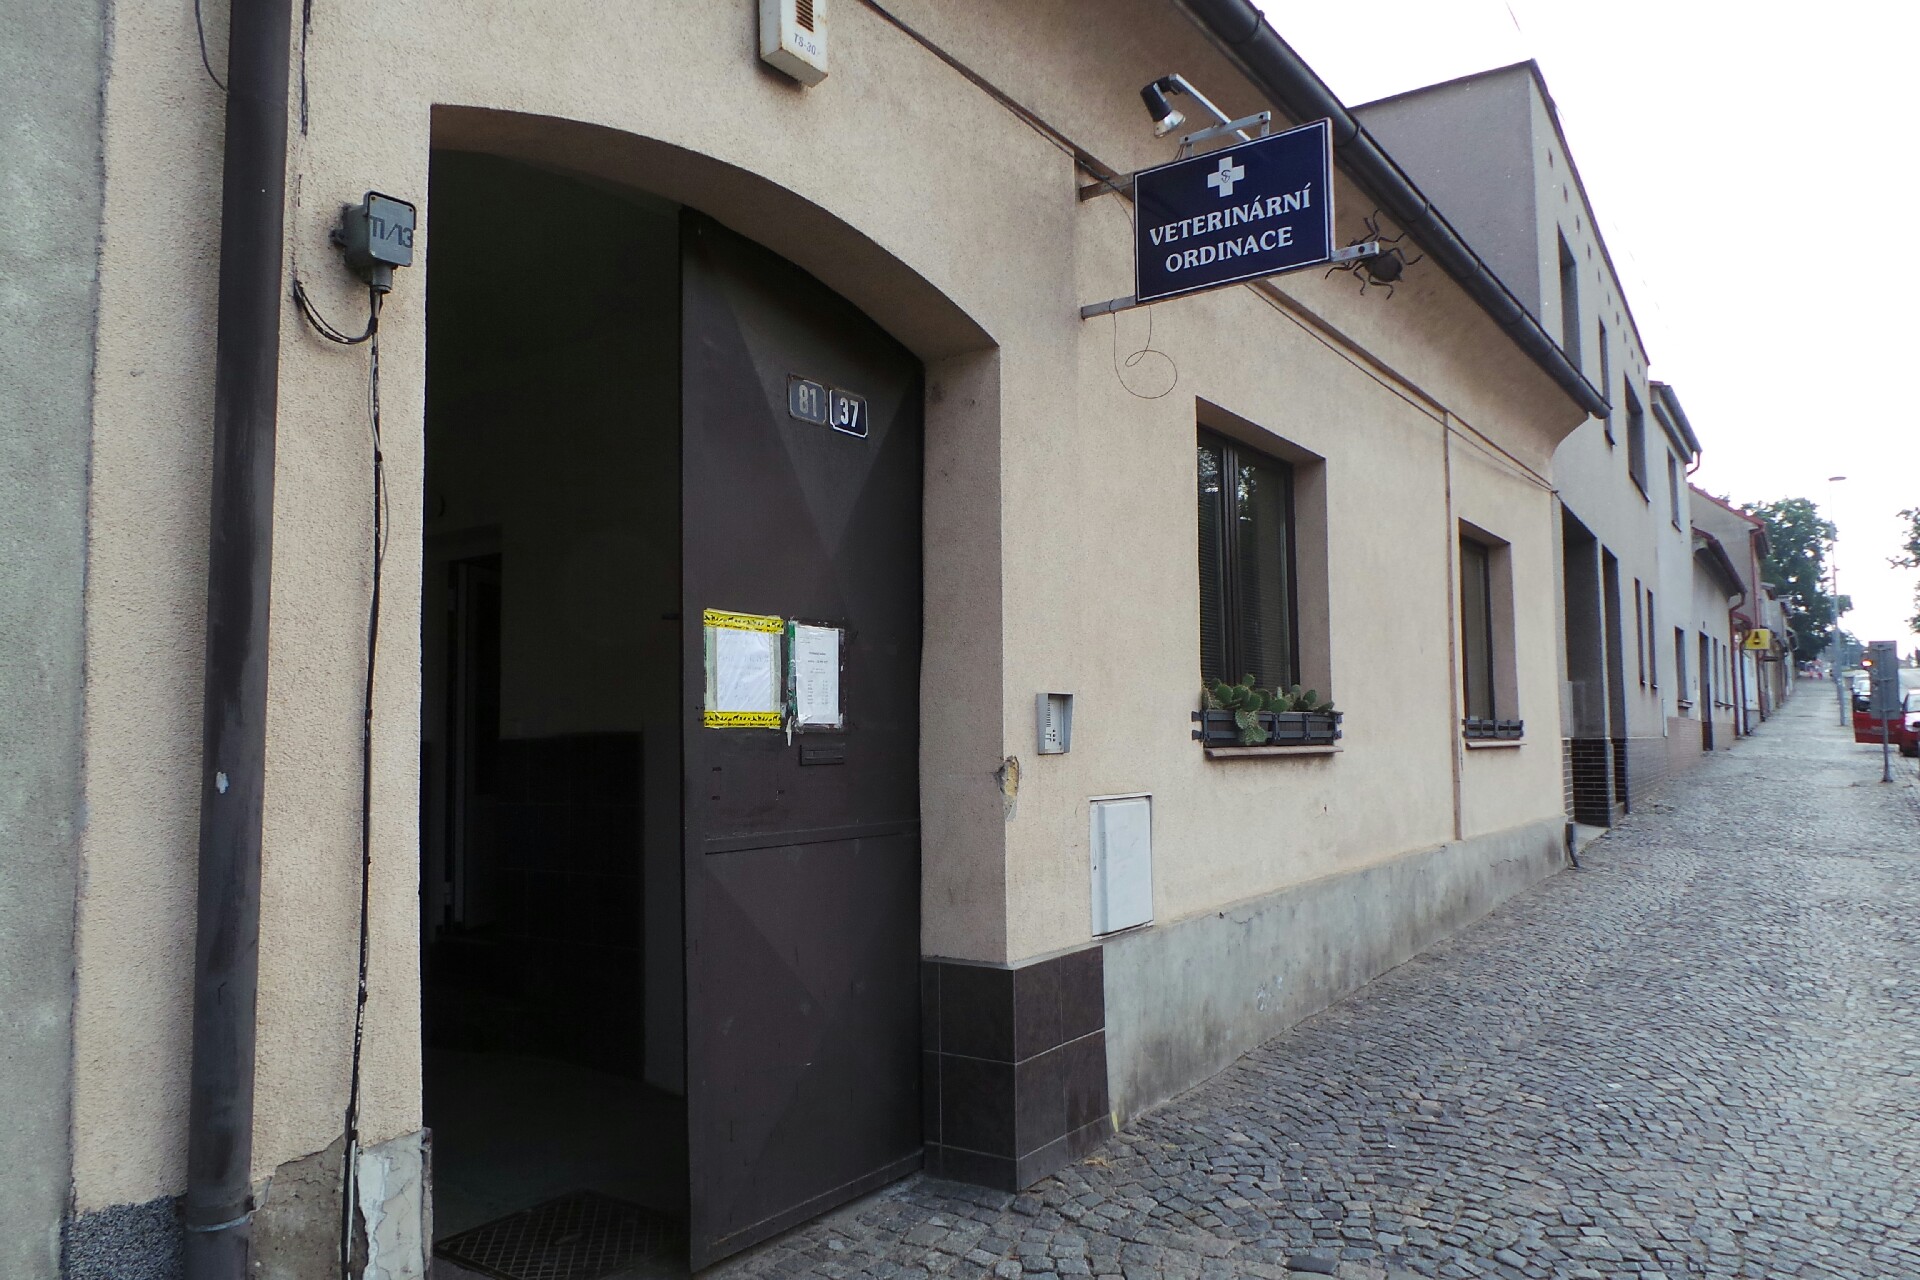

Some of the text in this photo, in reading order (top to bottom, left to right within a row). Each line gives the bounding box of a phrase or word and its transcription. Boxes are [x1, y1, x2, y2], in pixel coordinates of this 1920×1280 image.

[794, 33, 816, 55] TS-30
[1150, 182, 1311, 246] VETERINÁRNÍ
[1165, 226, 1293, 273] ORDINACE
[799, 384, 817, 417] 81
[840, 397, 859, 428] 37
